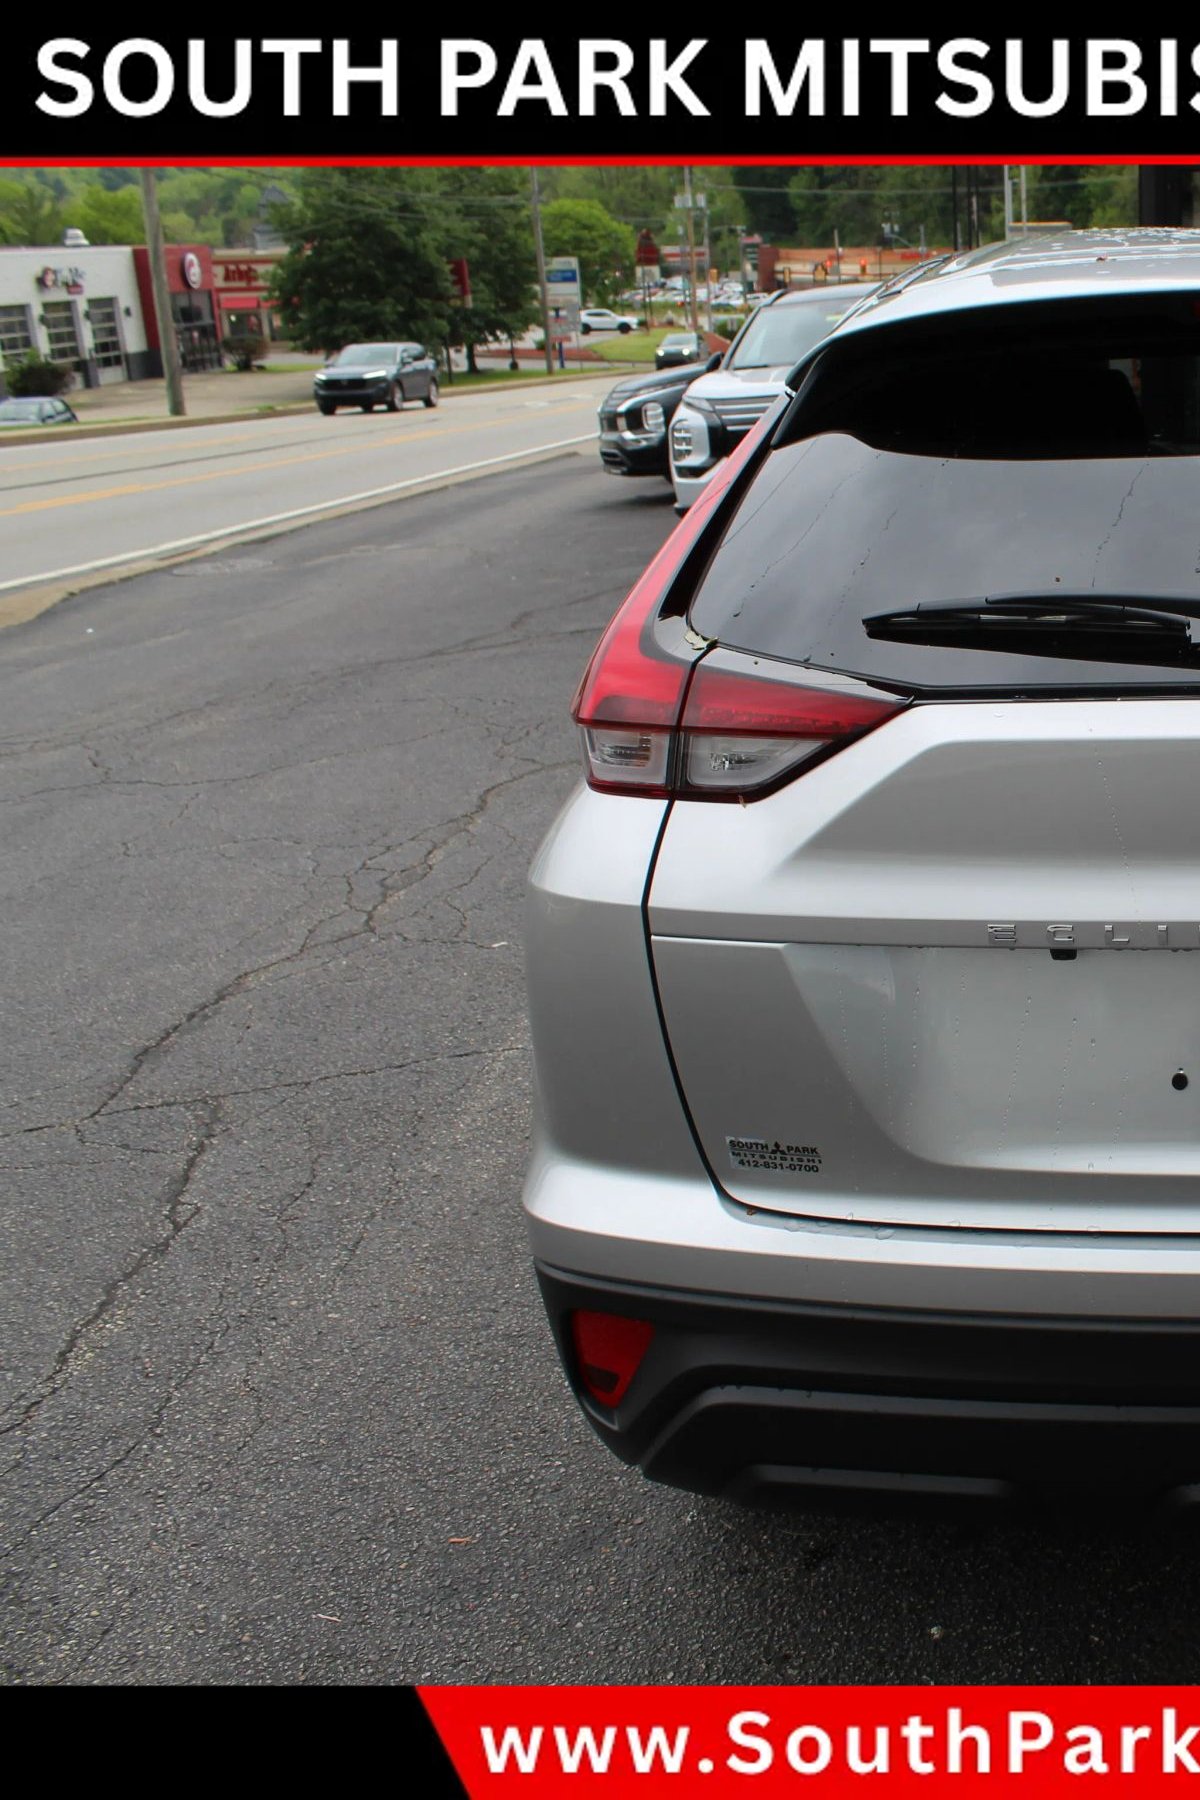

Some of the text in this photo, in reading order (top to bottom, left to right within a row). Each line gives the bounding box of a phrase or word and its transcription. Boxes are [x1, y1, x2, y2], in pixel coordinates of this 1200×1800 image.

[729, 1139, 819, 1155] SOUTH PARK
[731, 1151, 823, 1164] MITSUBISHI
[738, 1159, 819, 1173] 412-831-0700
